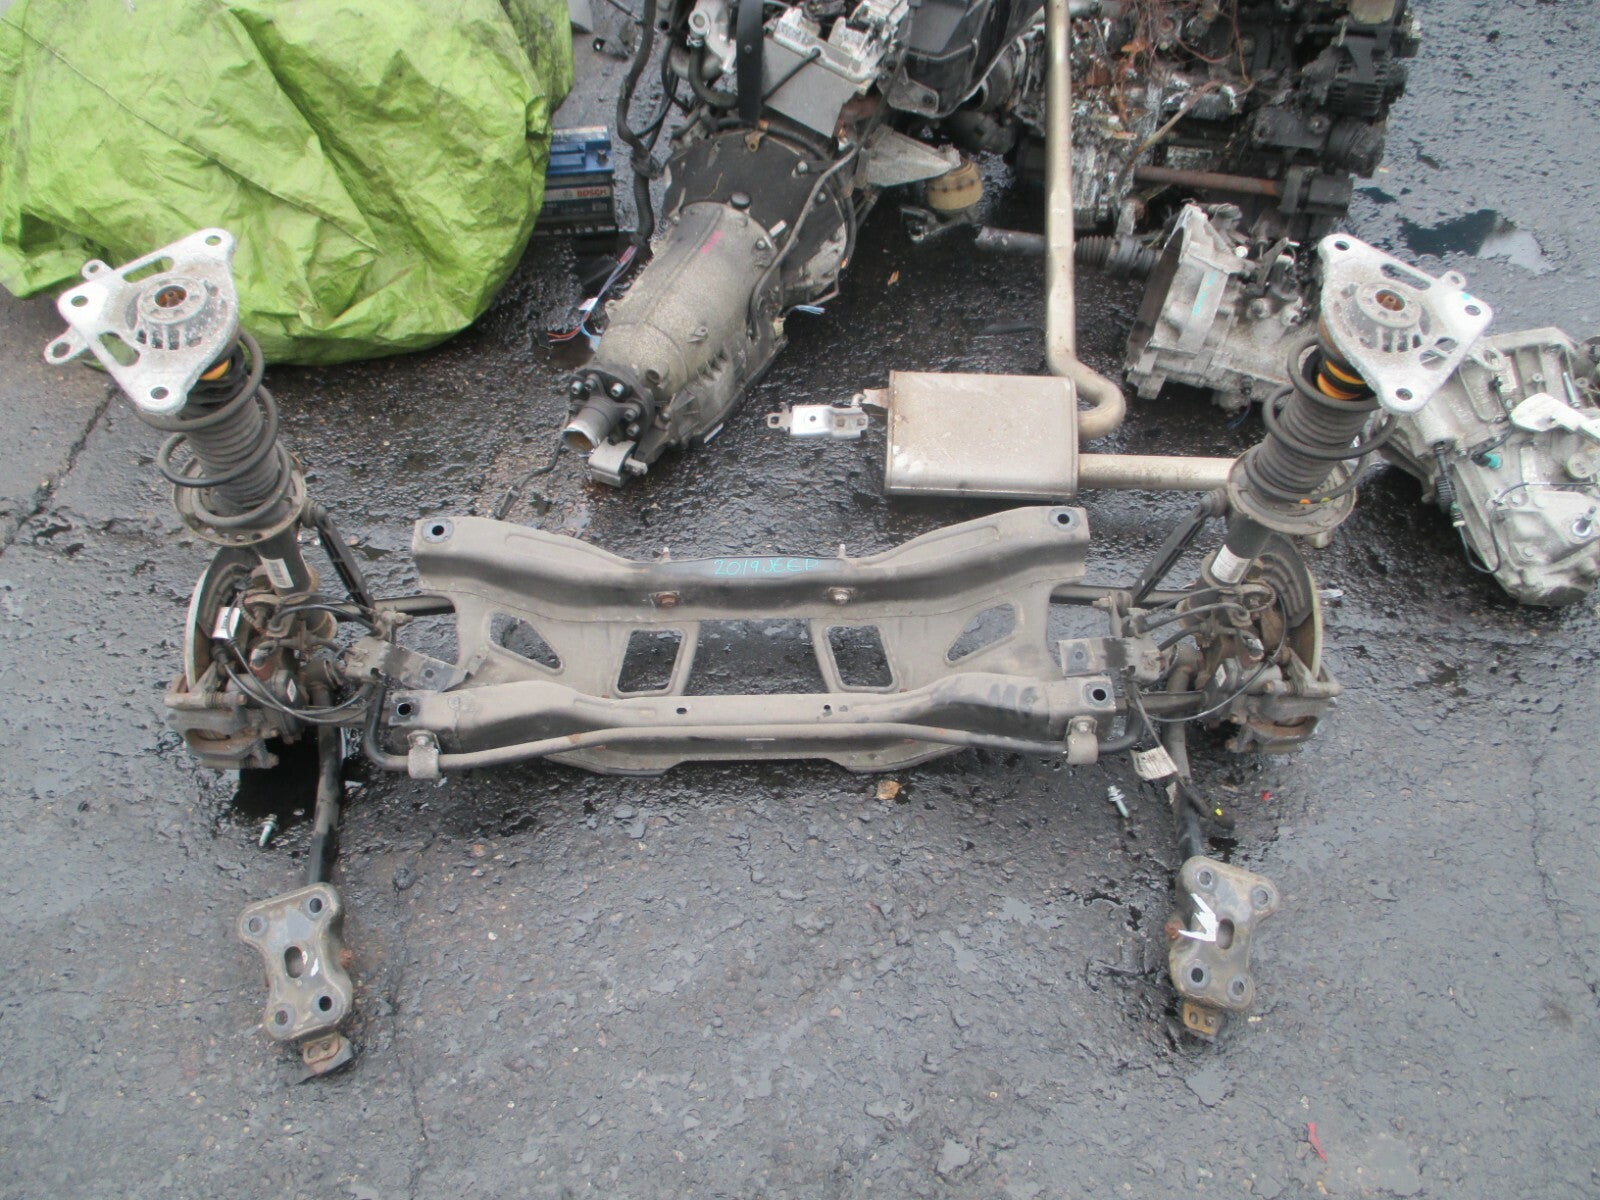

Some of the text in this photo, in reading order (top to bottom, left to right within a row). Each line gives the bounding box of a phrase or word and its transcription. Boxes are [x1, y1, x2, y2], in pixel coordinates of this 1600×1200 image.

[577, 188, 608, 197] BOSCH
[713, 557, 820, 576] 2019 JEEP
